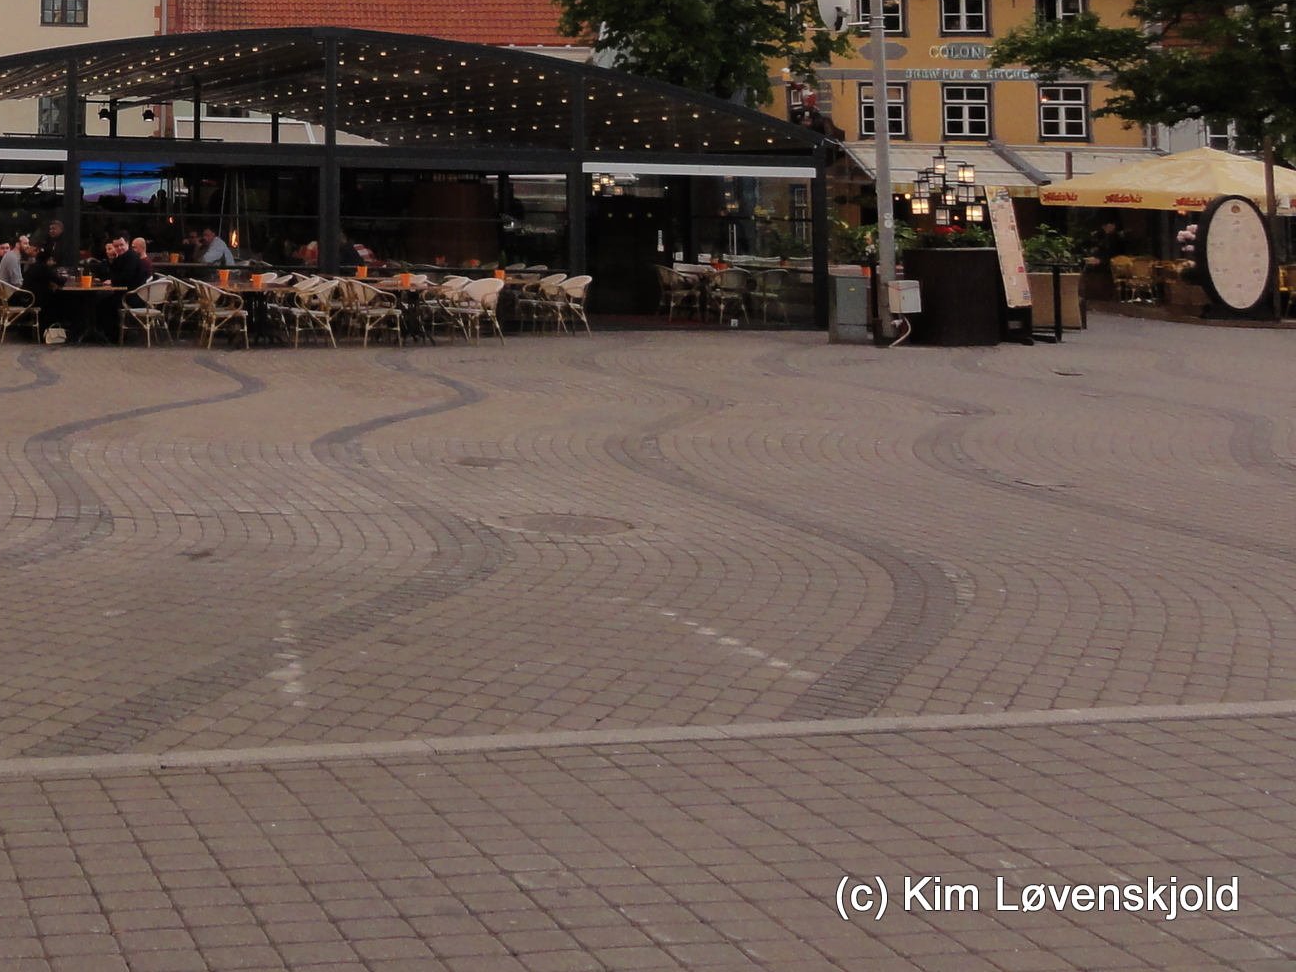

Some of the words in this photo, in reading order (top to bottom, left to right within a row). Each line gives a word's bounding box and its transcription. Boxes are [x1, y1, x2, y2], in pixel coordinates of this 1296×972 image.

[905, 68, 939, 79] BREW
[942, 68, 964, 79] PUB
[970, 68, 980, 79] &
